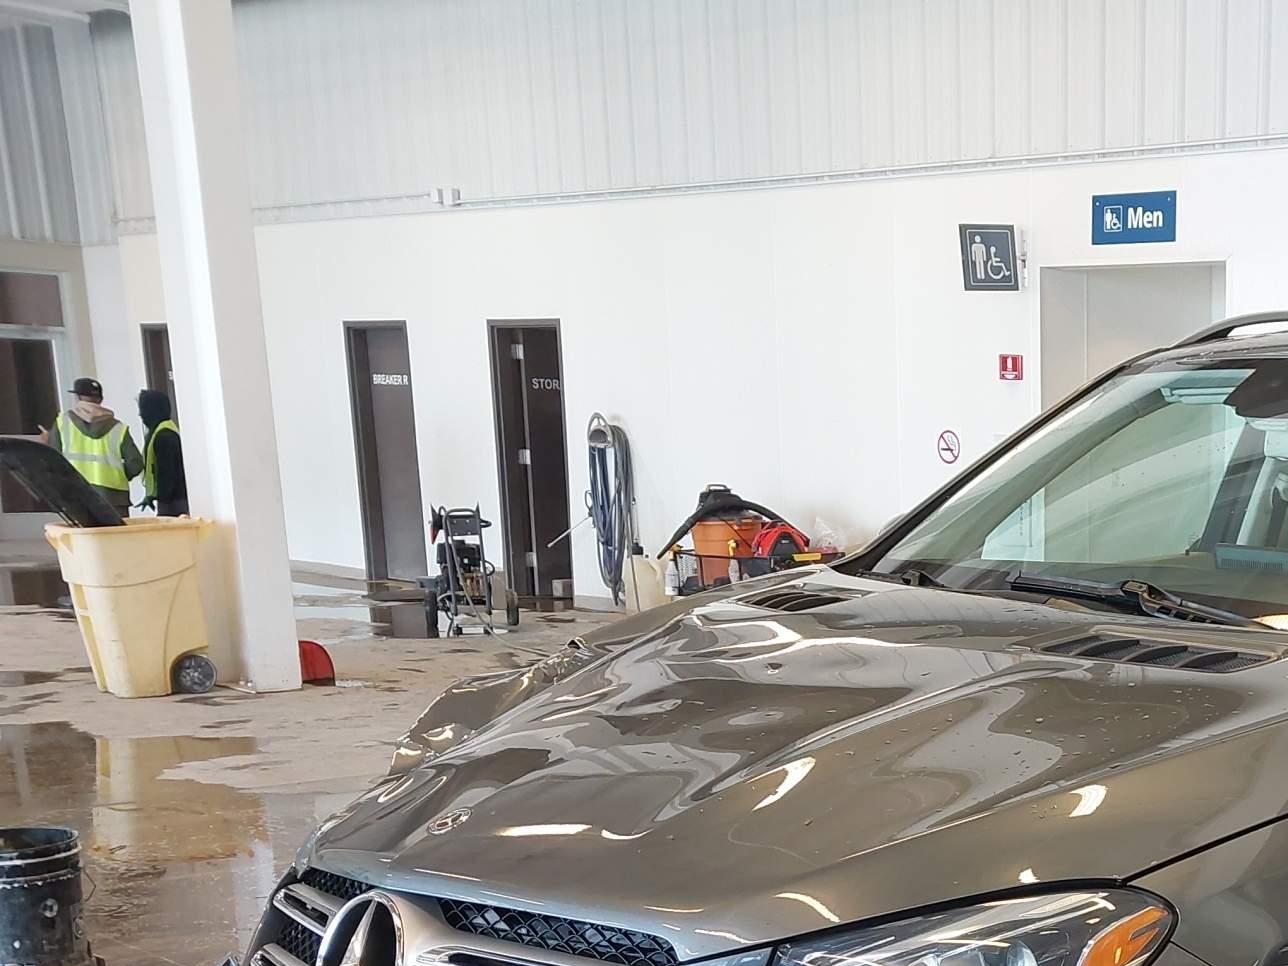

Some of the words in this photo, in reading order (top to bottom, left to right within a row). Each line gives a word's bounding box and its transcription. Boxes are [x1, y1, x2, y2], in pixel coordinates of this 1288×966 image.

[1127, 207, 1164, 229] Men
[372, 374, 402, 385] BREAKER
[402, 374, 409, 385] R
[532, 378, 560, 390] STOR
